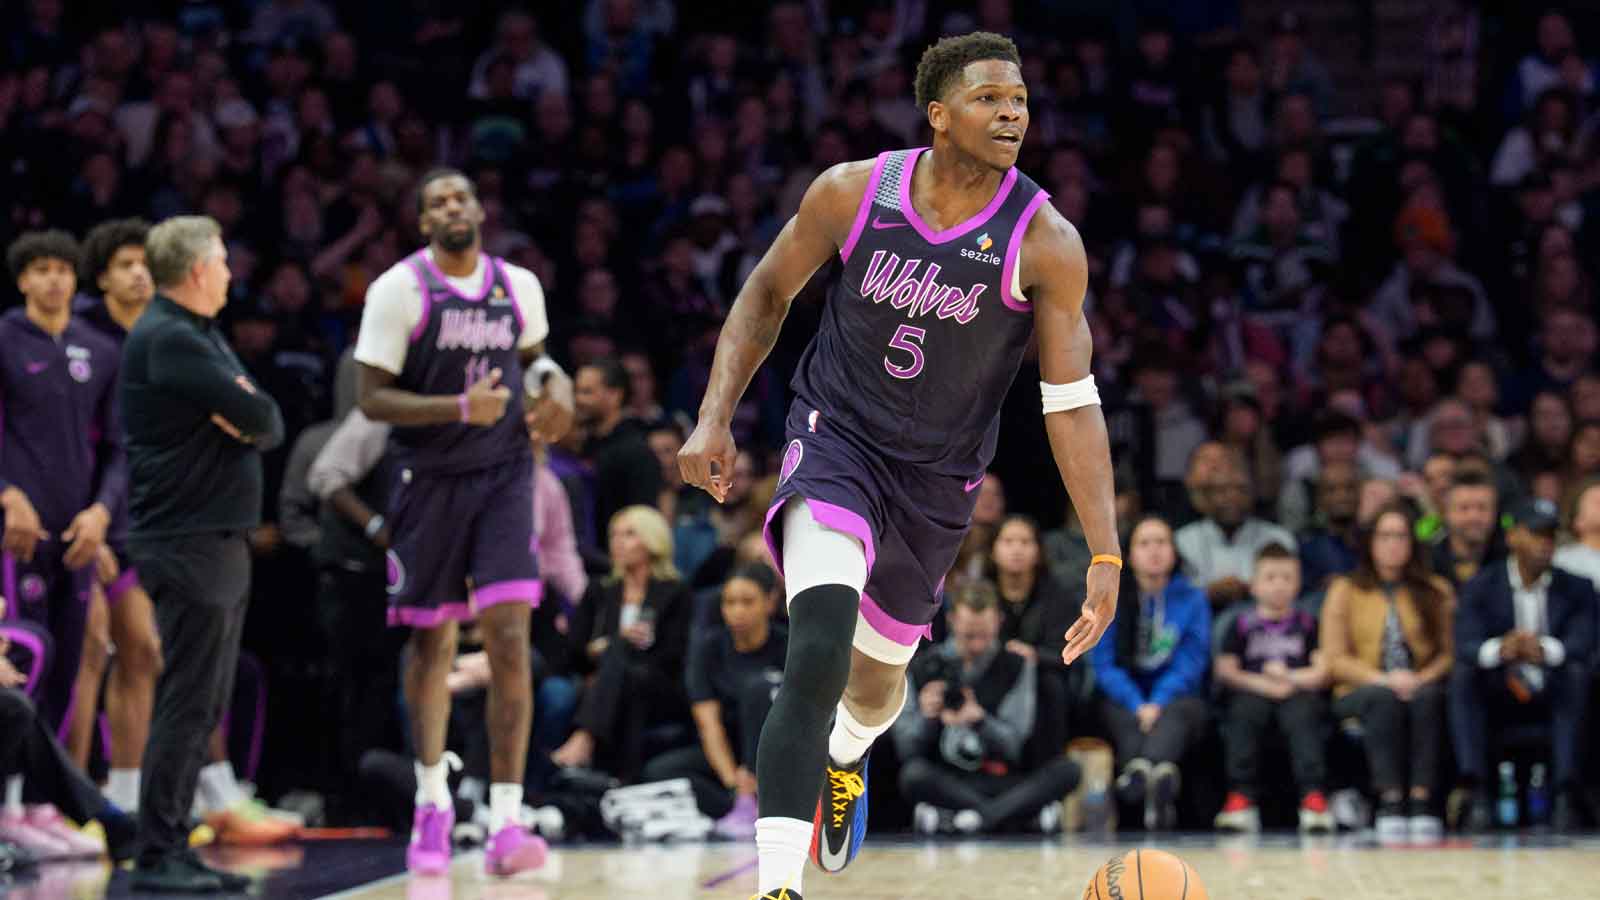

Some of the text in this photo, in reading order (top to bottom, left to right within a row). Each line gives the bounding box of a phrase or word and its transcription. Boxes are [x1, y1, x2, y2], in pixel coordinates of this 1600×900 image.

[960, 248, 1001, 265] sezzle
[860, 250, 988, 325] Wolves
[884, 324, 926, 379] 5
